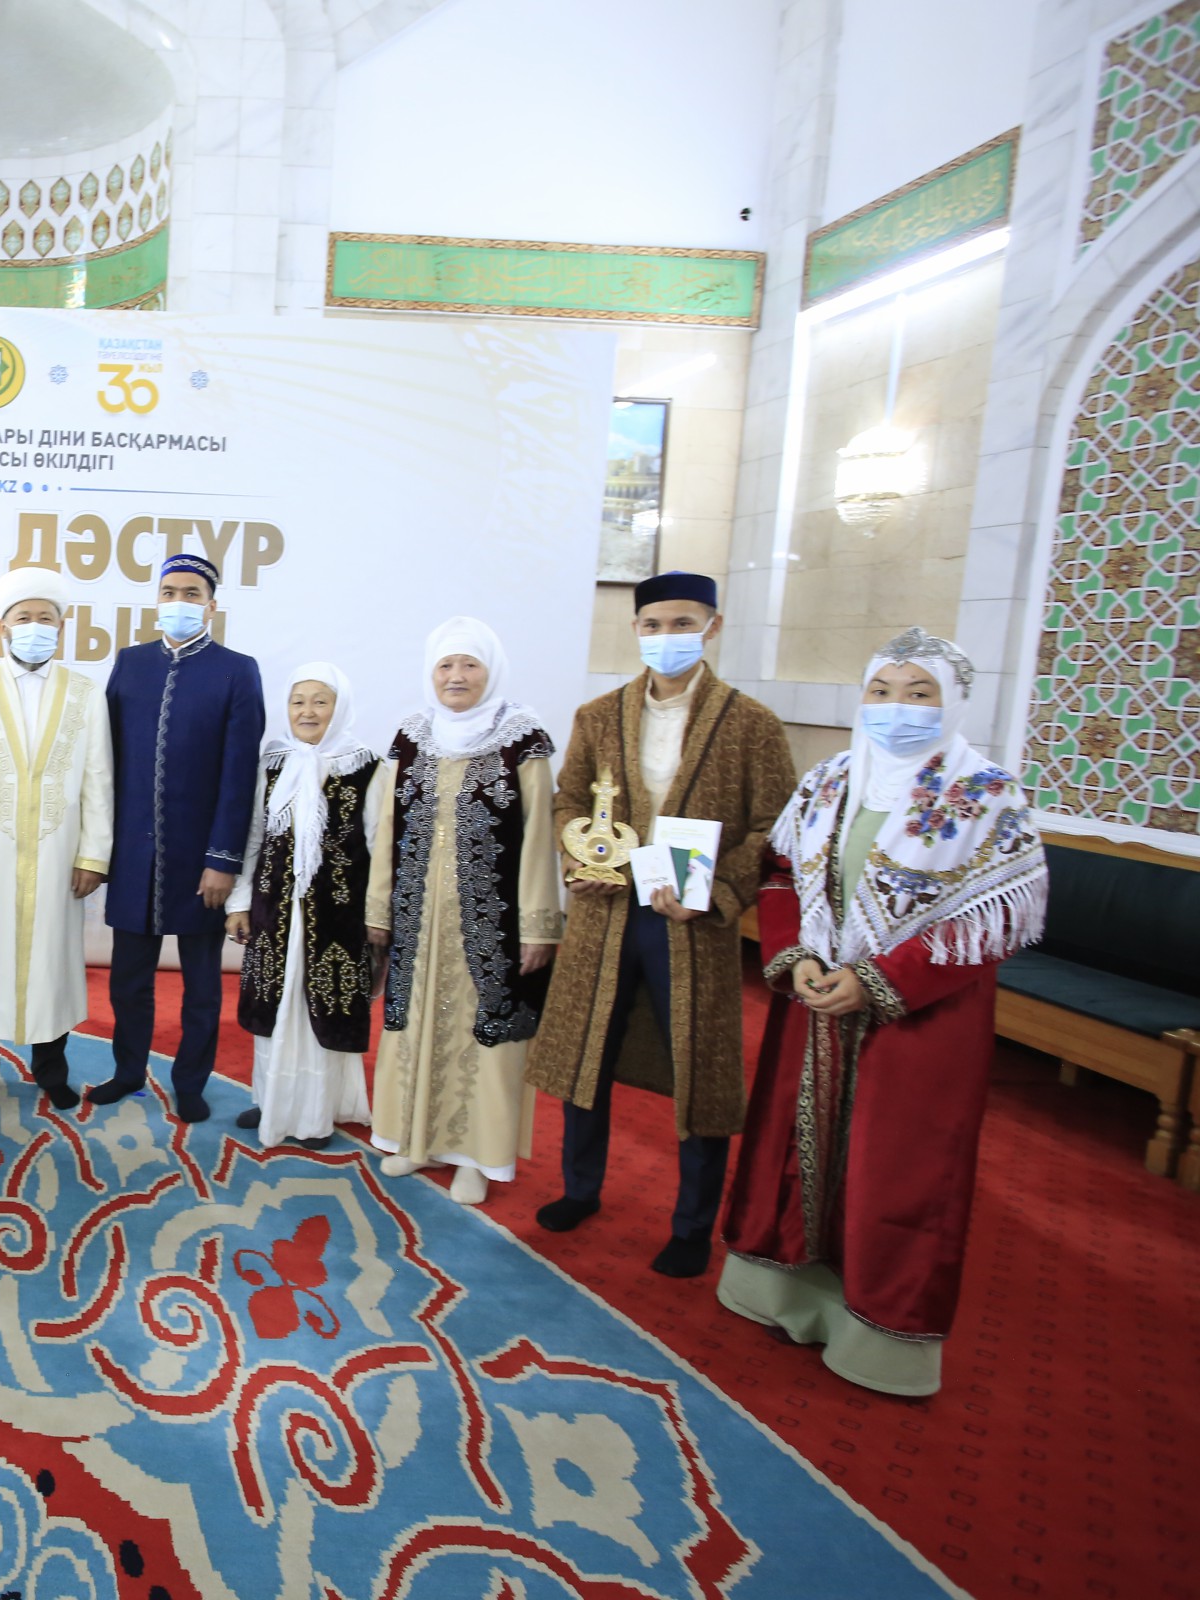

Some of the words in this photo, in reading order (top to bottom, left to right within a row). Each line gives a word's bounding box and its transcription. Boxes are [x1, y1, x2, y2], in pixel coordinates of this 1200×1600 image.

[97, 363, 159, 414] 30
[38, 430, 86, 449] ДІНИ
[91, 432, 227, 452] БАСҚАРМАСЫ
[33, 452, 114, 472] ӨКІЛДІГІ
[9, 512, 284, 587] ДӘСТҮР
